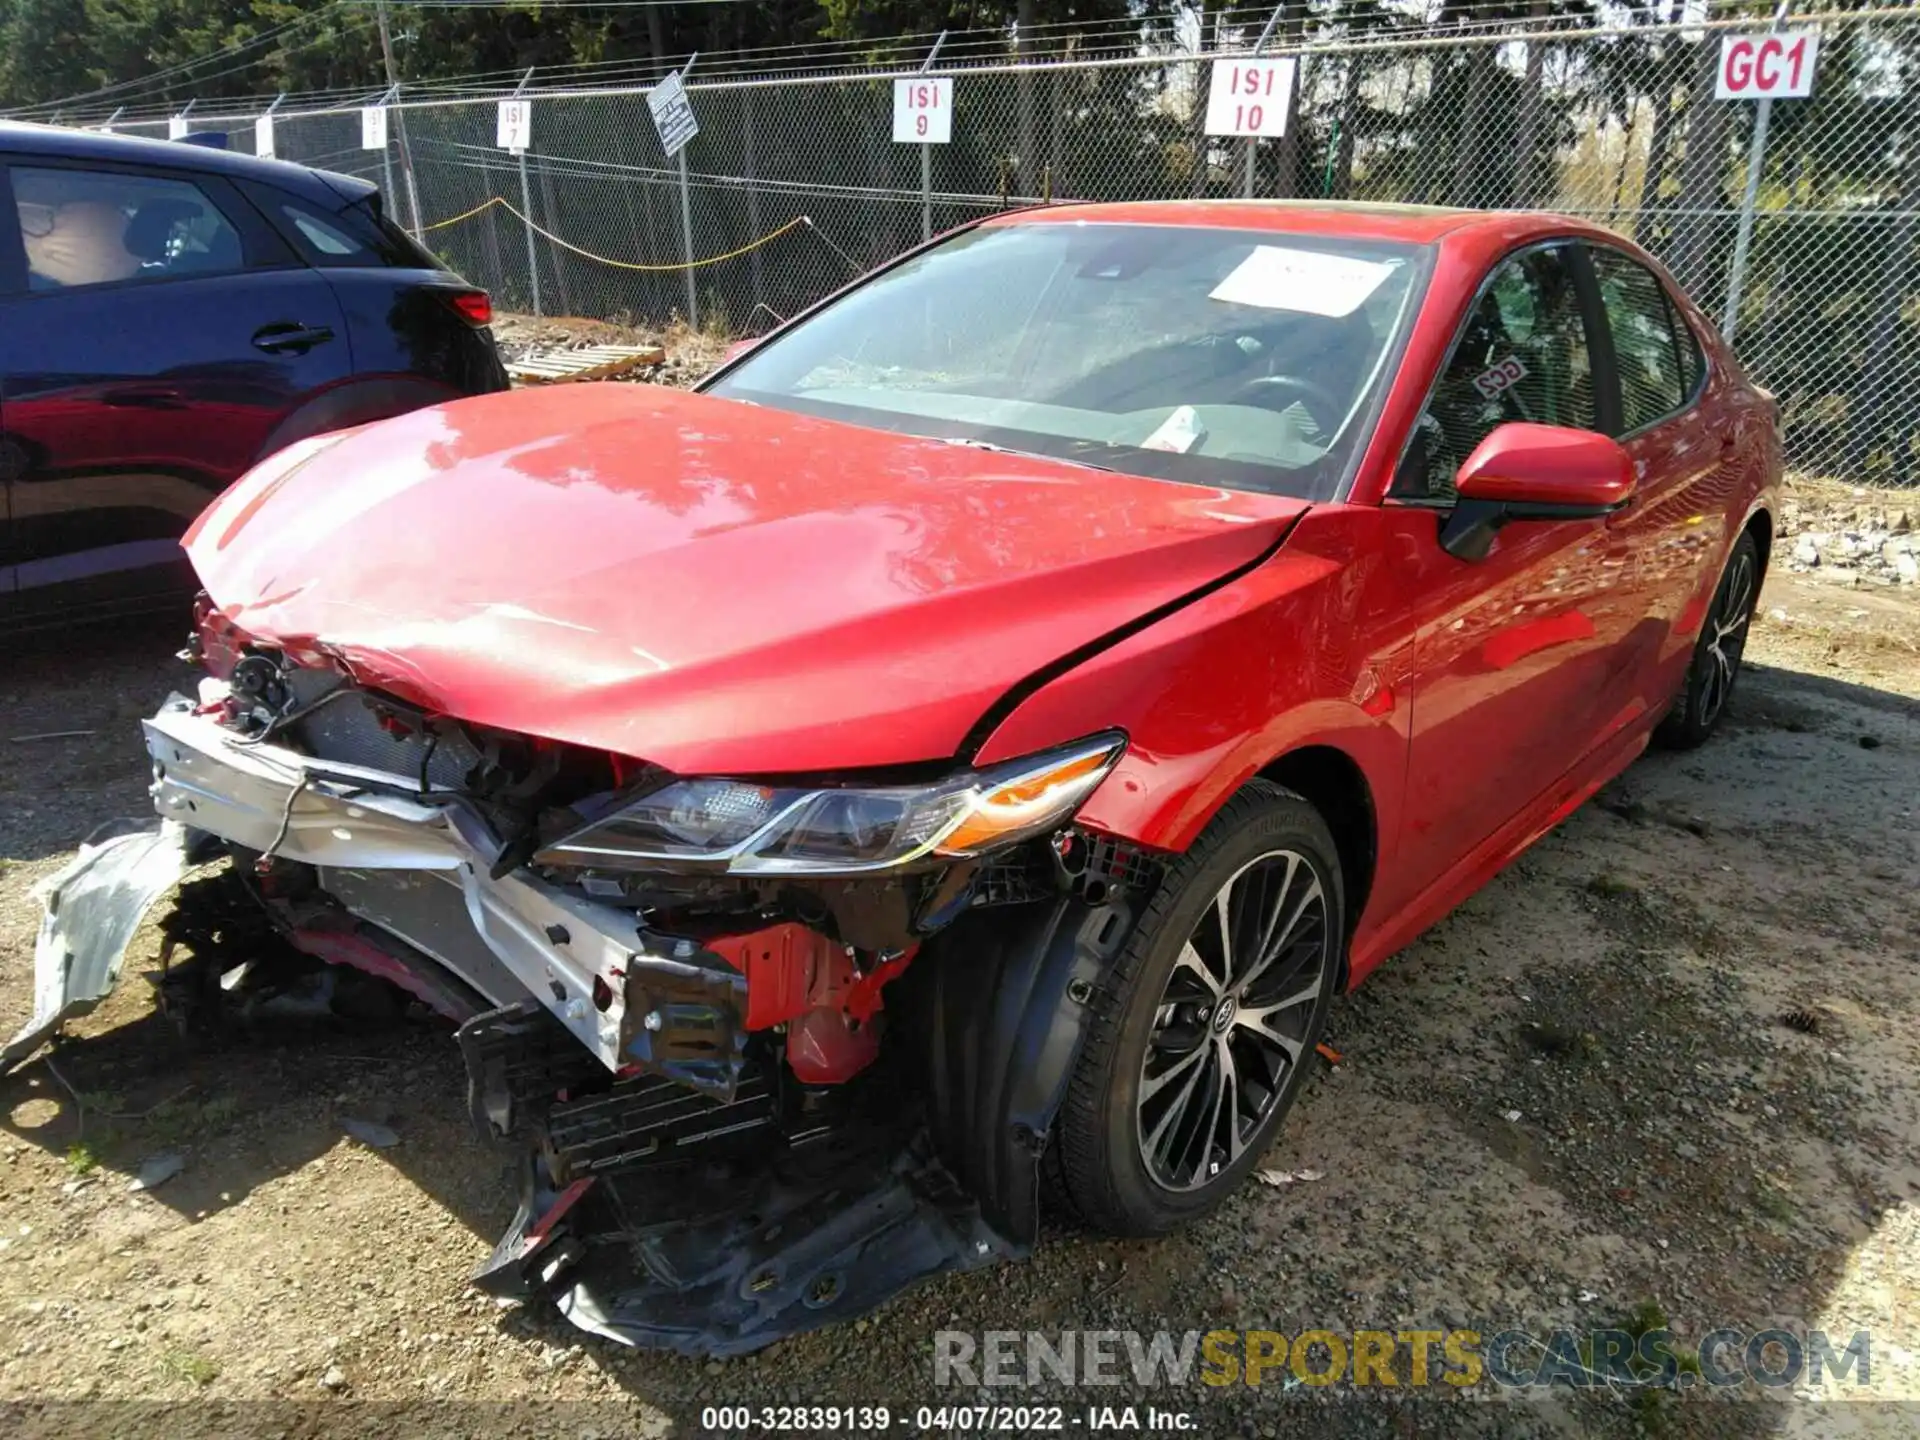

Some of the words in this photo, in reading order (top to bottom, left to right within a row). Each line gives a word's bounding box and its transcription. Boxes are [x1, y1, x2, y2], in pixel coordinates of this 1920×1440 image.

[1725, 37, 1807, 92] GC1
[916, 114, 928, 137] 9
[1235, 104, 1263, 131] 10
